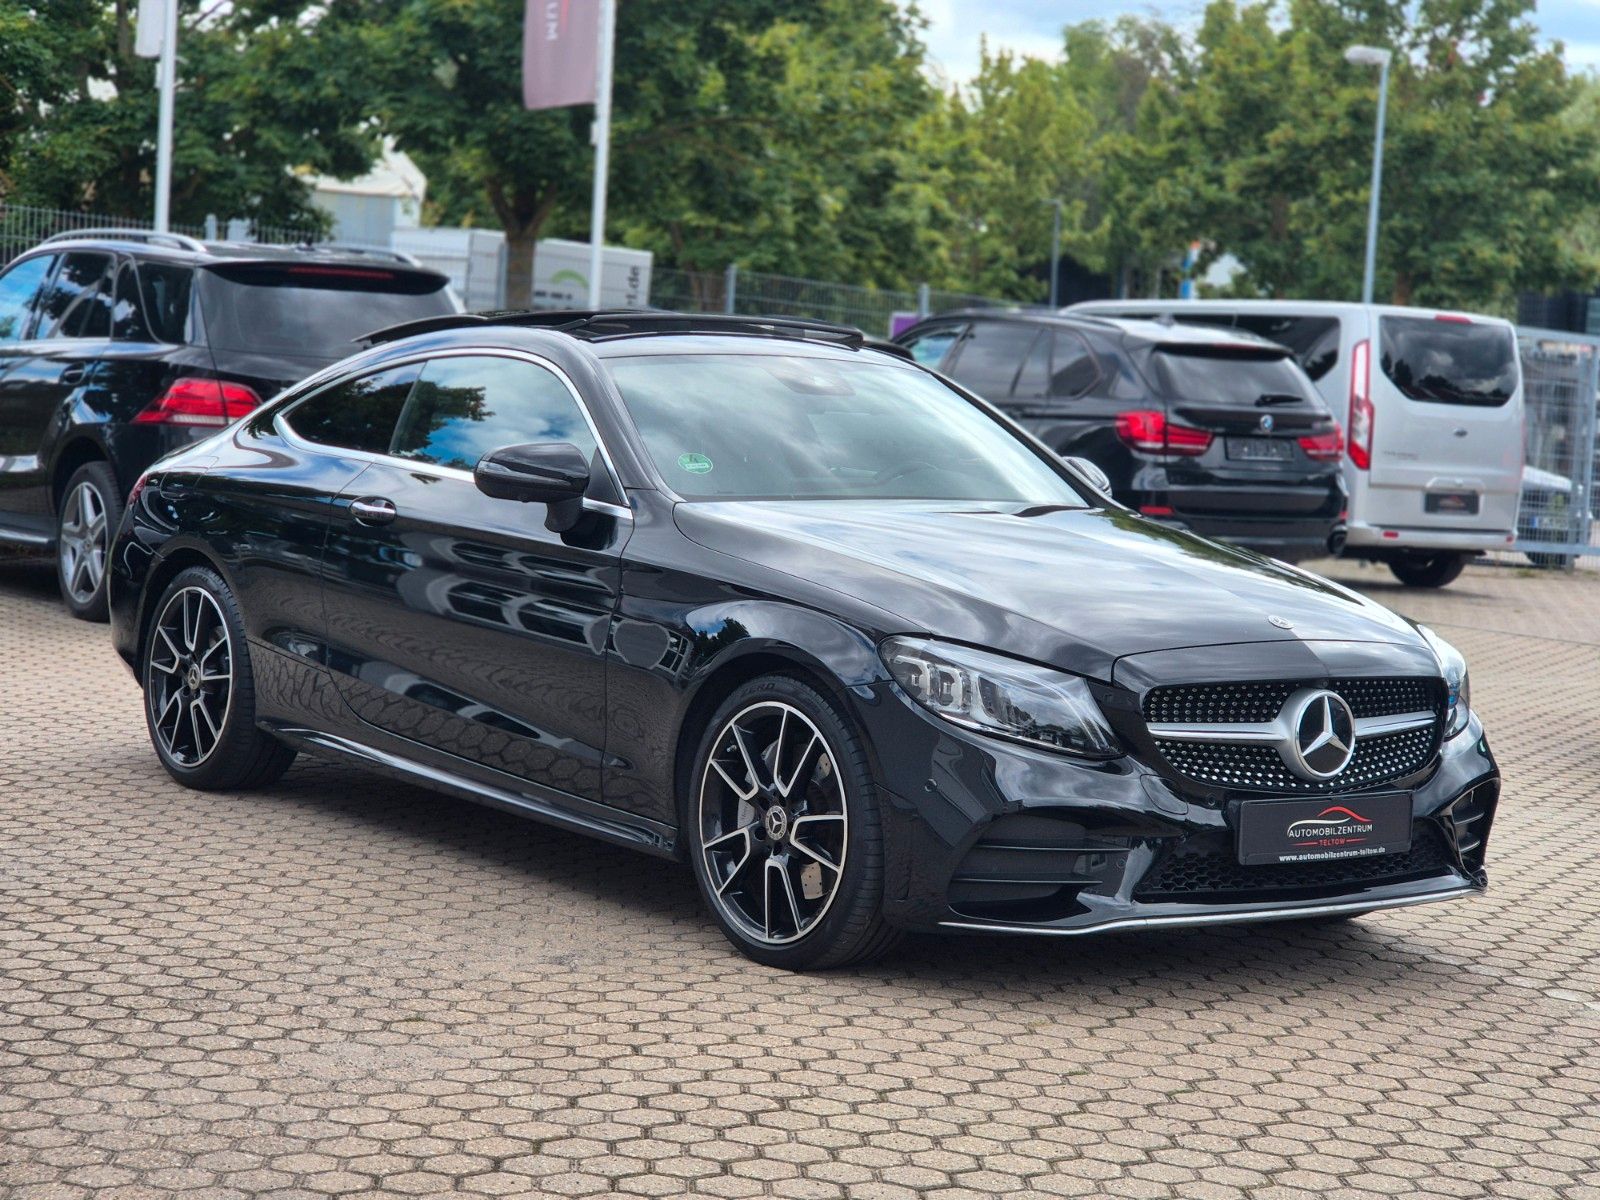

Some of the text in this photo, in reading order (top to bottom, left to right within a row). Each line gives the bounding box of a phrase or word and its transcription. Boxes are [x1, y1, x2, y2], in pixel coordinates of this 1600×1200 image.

[1288, 824, 1373, 838] AUTOMOBILZENTRUM
[1319, 838, 1346, 847] TELTOW
[1278, 846, 1386, 862] www.automobilzentrum-teltow.de
